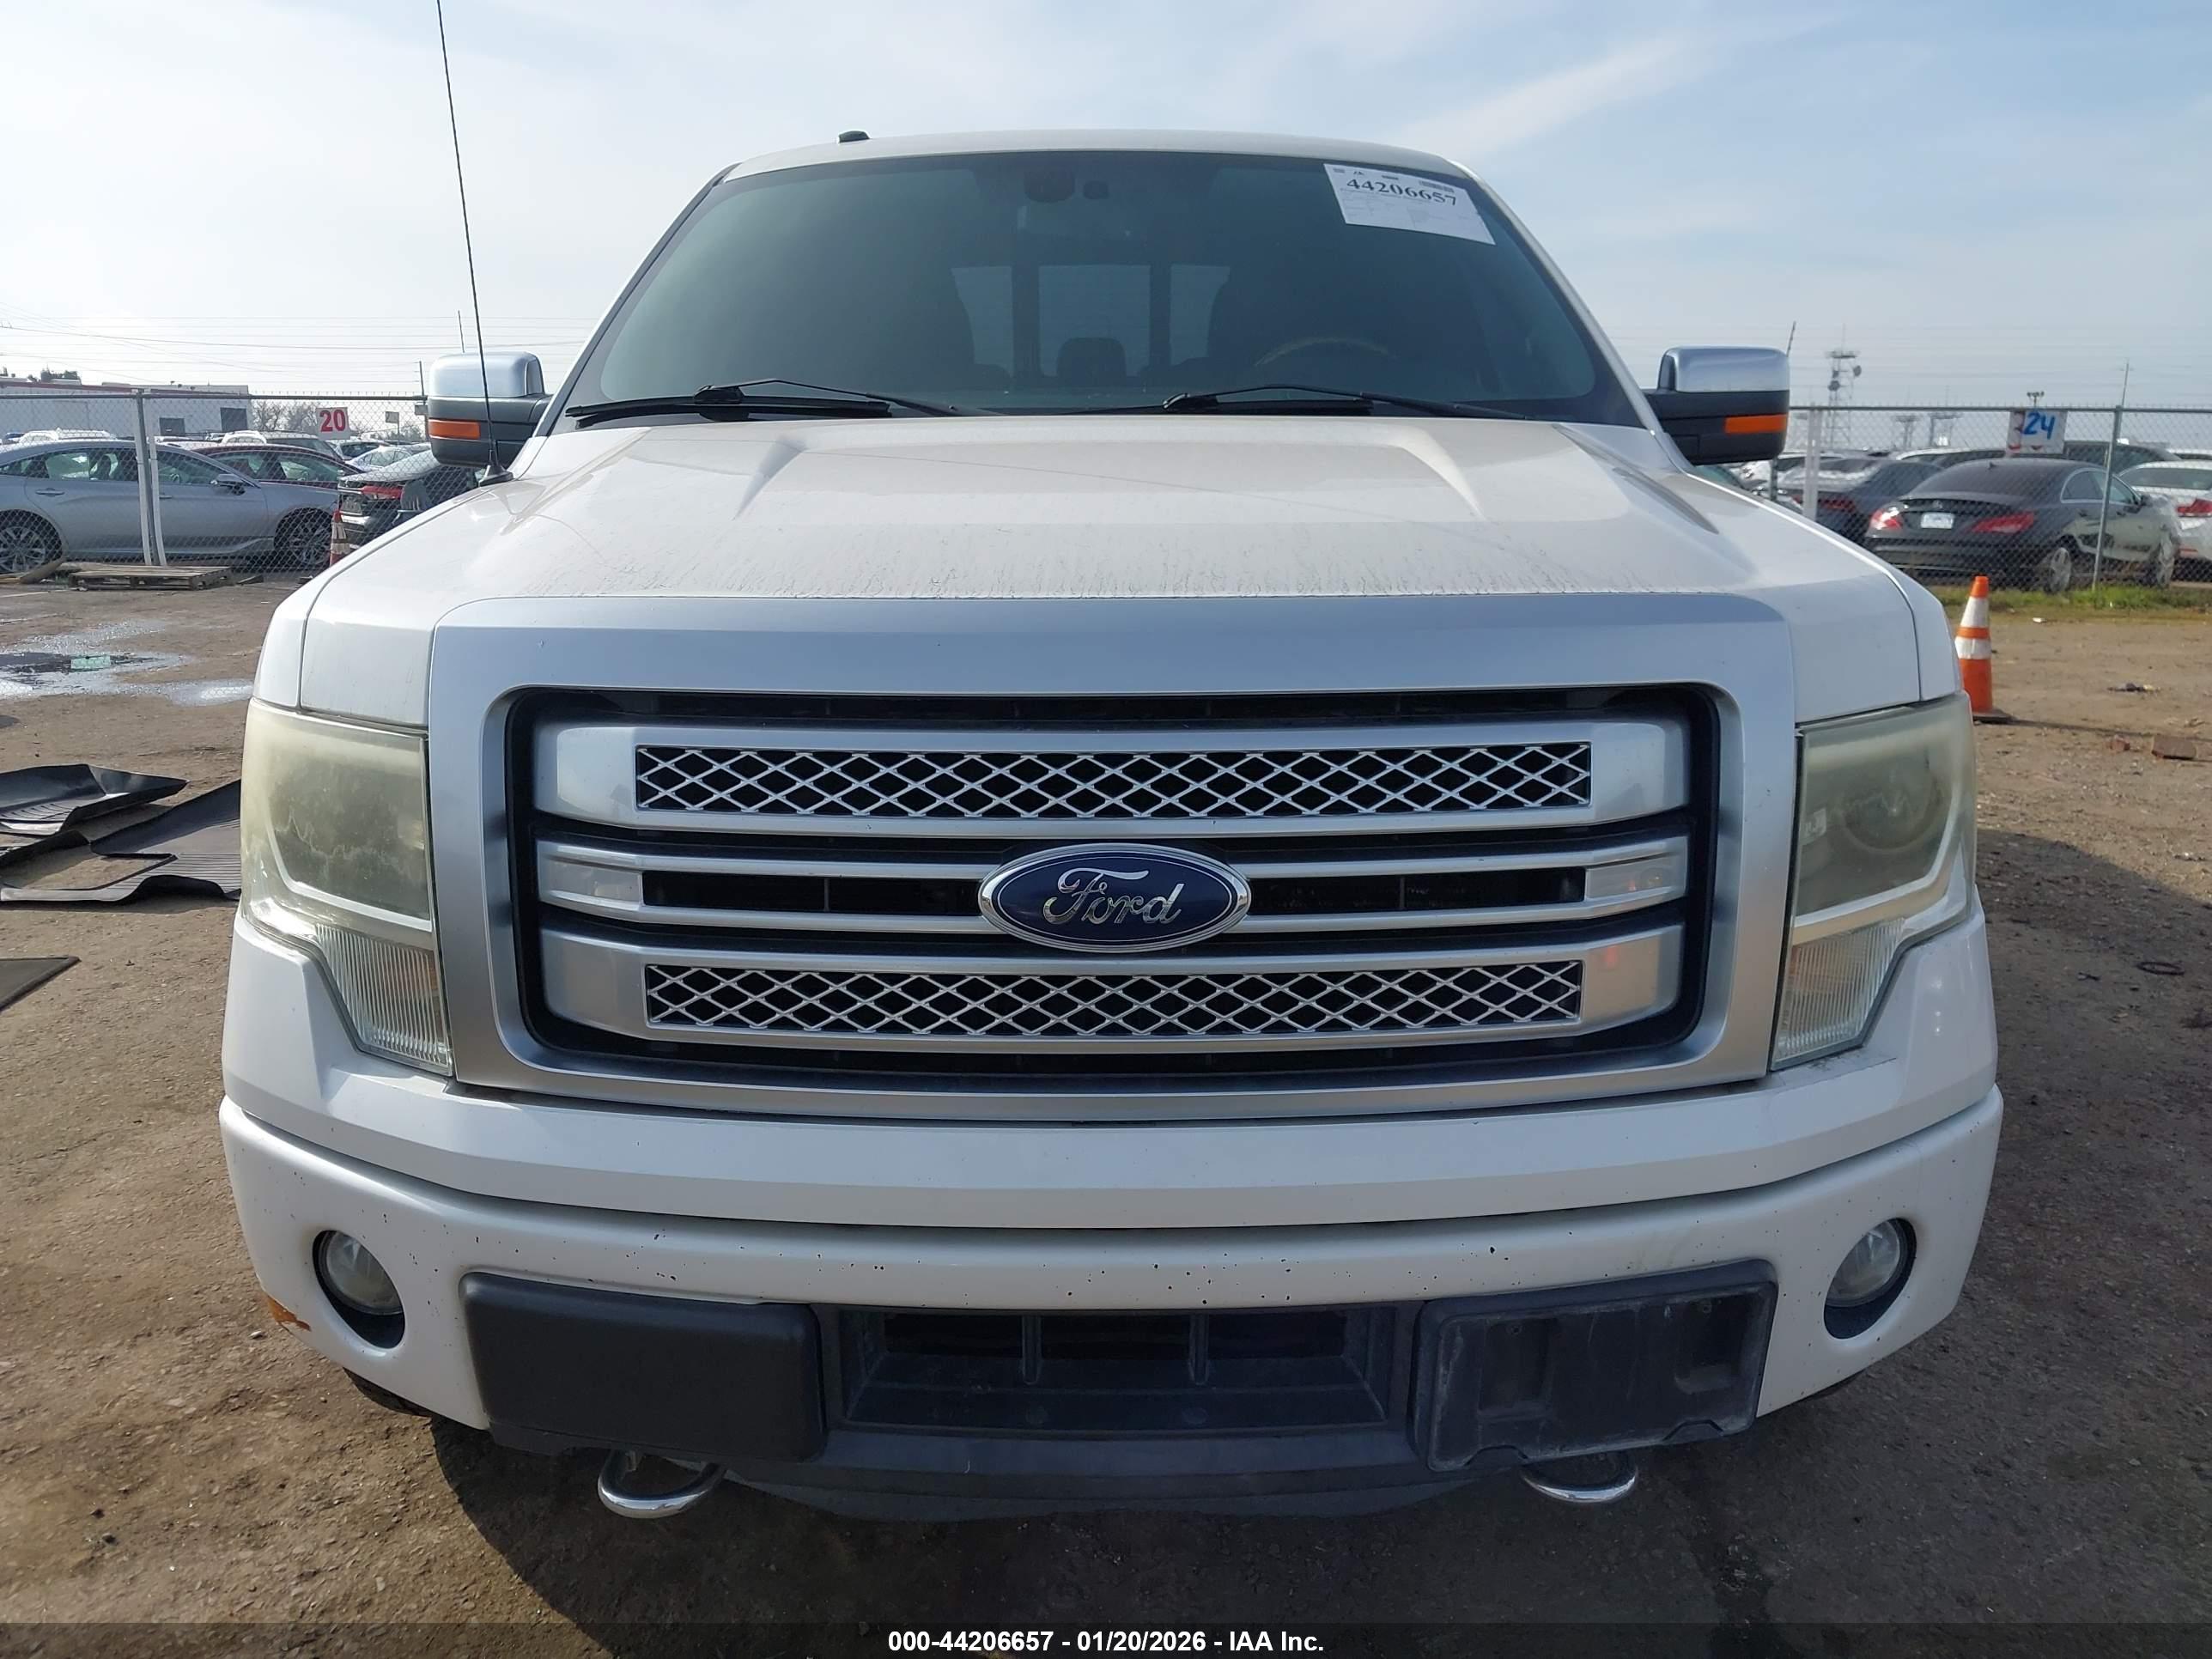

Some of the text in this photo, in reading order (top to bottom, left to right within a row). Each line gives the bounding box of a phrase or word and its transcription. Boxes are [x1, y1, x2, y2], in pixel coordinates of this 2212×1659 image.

[1346, 179, 1456, 206] 44206657
[319, 410, 345, 432] 20
[2023, 411, 2056, 440] 24
[1042, 867, 1185, 925] Ford
